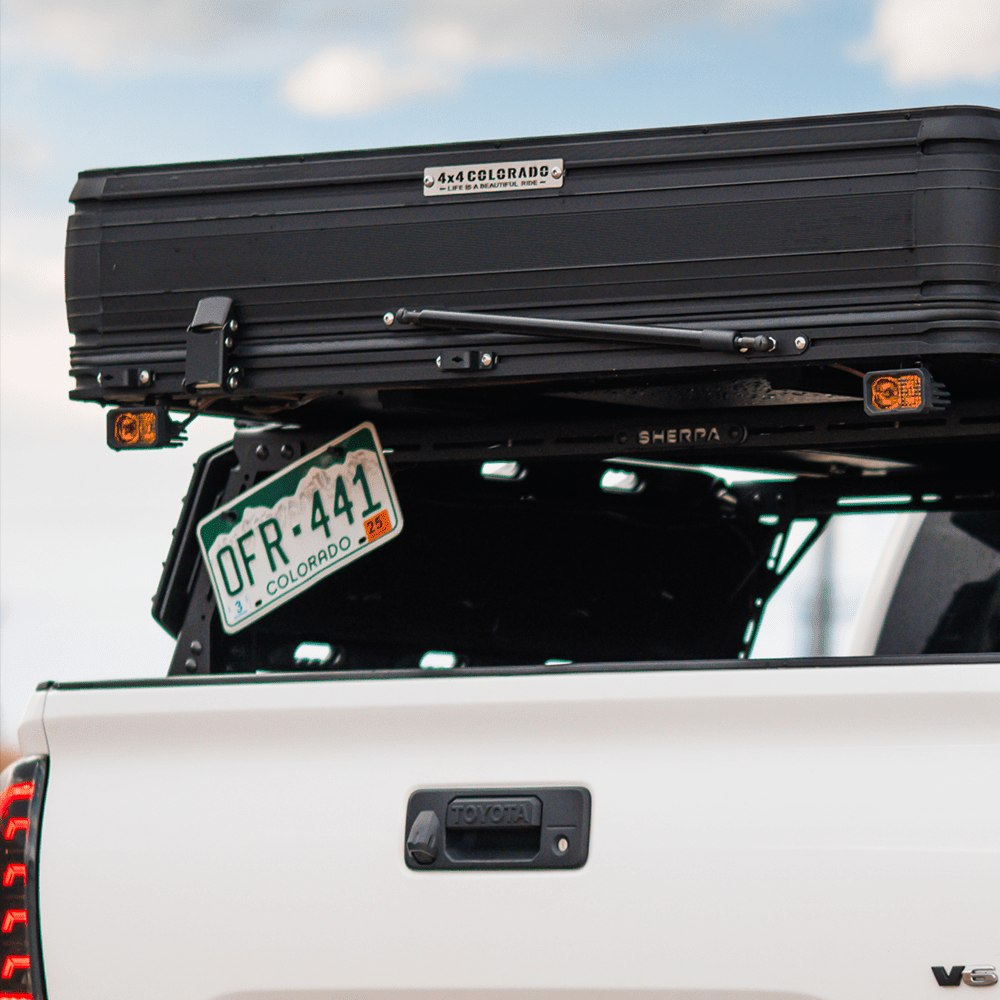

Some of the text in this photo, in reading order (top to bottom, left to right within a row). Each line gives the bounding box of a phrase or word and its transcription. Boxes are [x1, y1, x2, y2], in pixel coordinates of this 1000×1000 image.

[447, 184, 464, 192] LIFE
[480, 181, 519, 190] BEAUTIFUL
[521, 179, 537, 187] RIDE
[638, 427, 720, 445] SHERPA
[366, 515, 383, 535] 25
[266, 536, 352, 596] COLORADO
[451, 804, 531, 825] TOYOTA
[931, 964, 999, 987] V6
